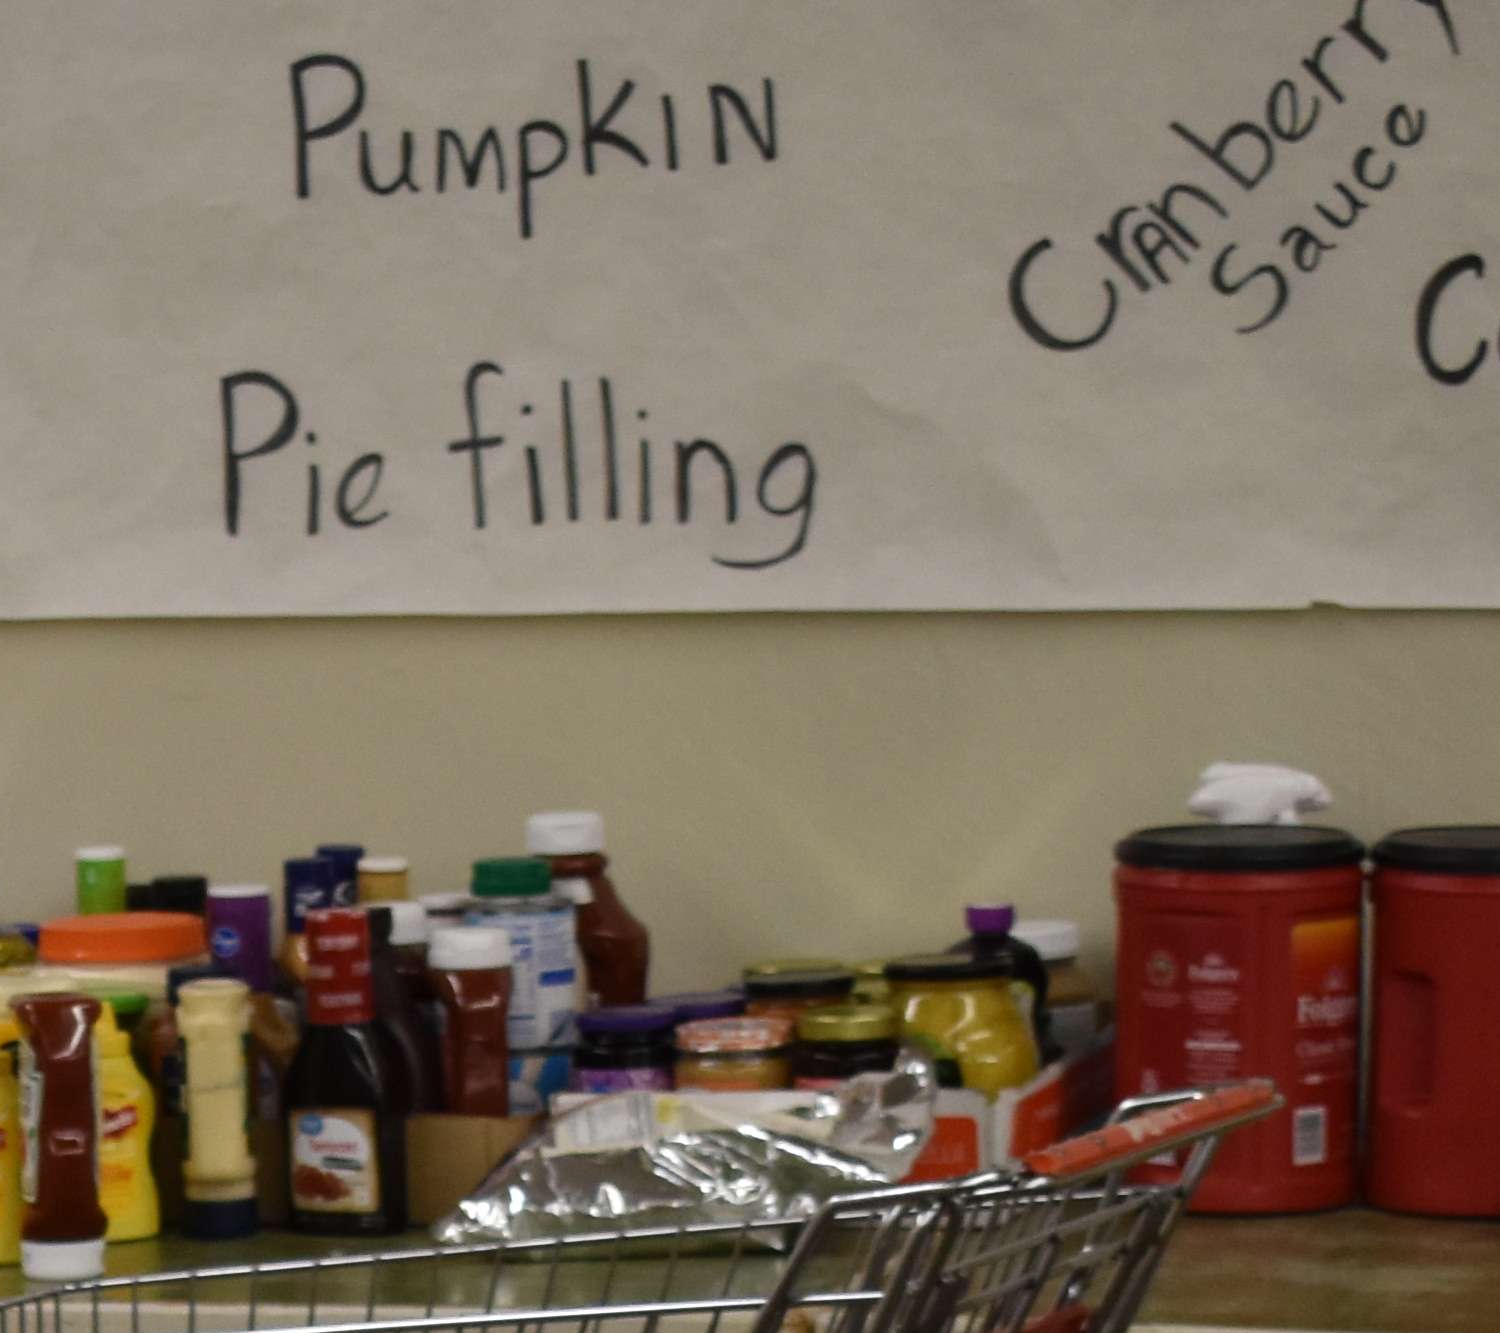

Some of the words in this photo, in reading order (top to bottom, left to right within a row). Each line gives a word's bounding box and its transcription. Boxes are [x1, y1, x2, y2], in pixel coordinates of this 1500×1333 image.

[1208, 100, 1430, 334] Sauce
[222, 368, 390, 538] Pie
[448, 360, 818, 570] filling
